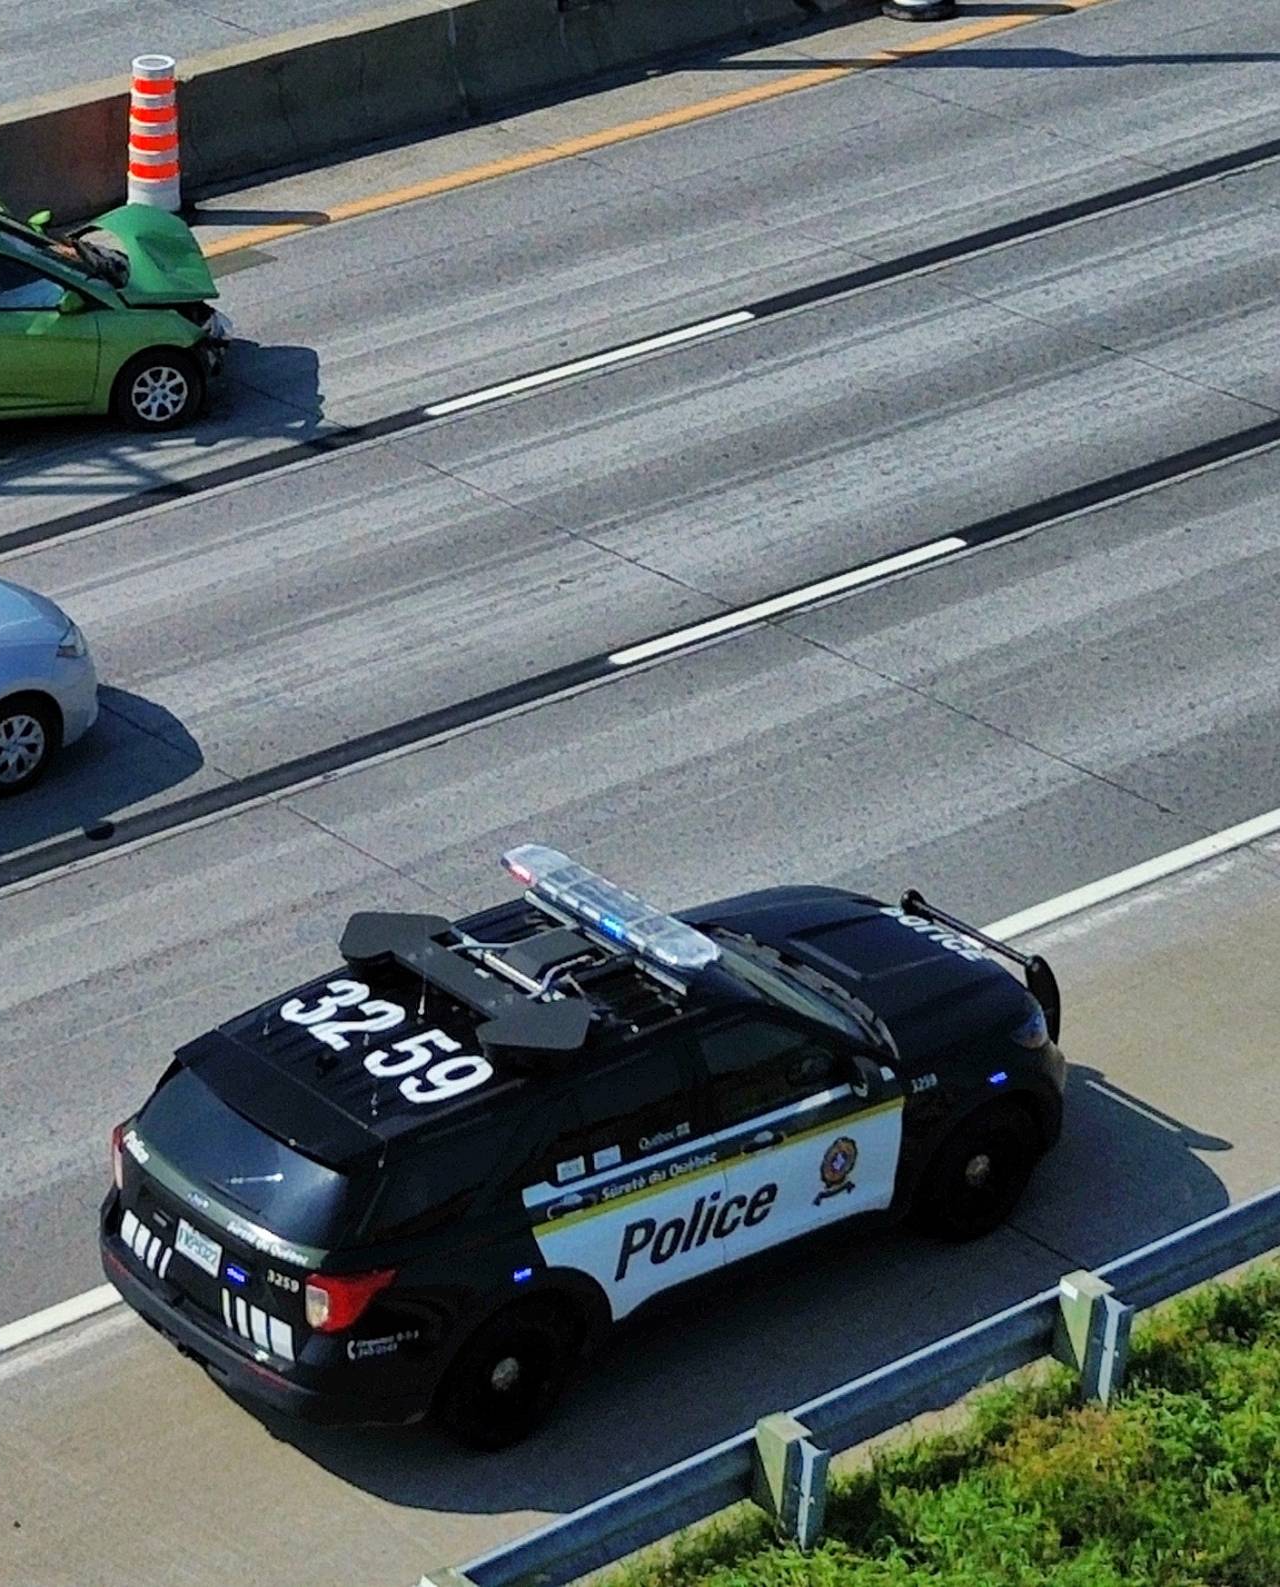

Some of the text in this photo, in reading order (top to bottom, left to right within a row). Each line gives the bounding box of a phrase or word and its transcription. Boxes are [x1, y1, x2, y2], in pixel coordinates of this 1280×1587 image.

[648, 1168, 667, 1185] du
[614, 1182, 778, 1283] Police
[266, 1268, 300, 1293] 3259
